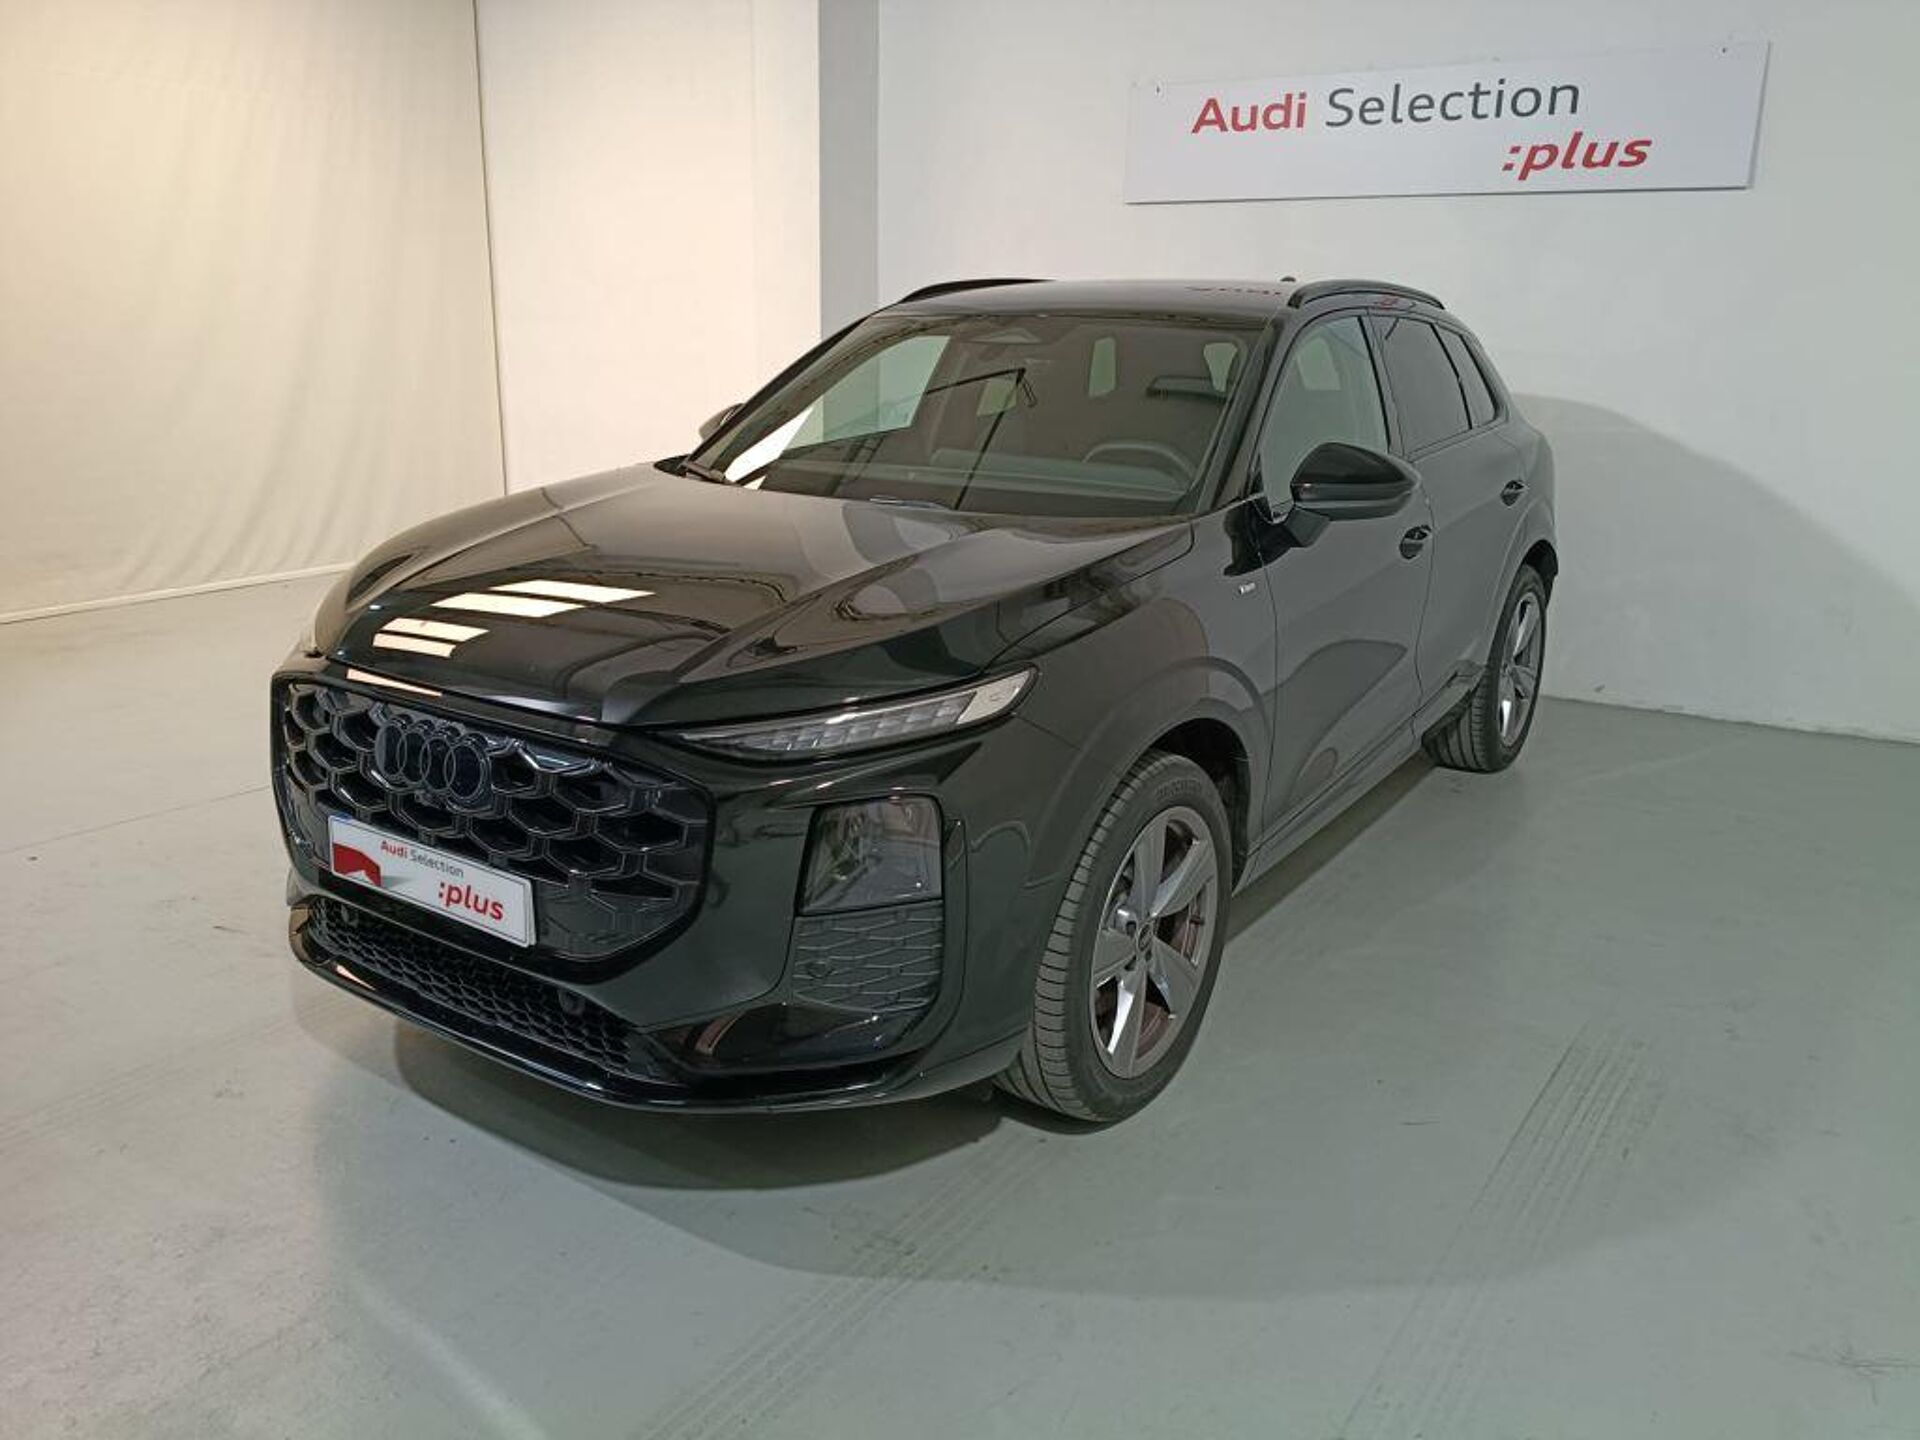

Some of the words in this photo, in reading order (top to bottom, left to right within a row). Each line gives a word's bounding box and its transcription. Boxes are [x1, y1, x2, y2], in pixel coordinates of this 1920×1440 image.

[1192, 91, 1307, 134] Audi
[1325, 78, 1580, 127] Selection
[1501, 131, 1652, 180] :plus
[380, 840, 408, 859] Audi
[410, 850, 464, 878] Selection
[438, 881, 504, 921] :plus
